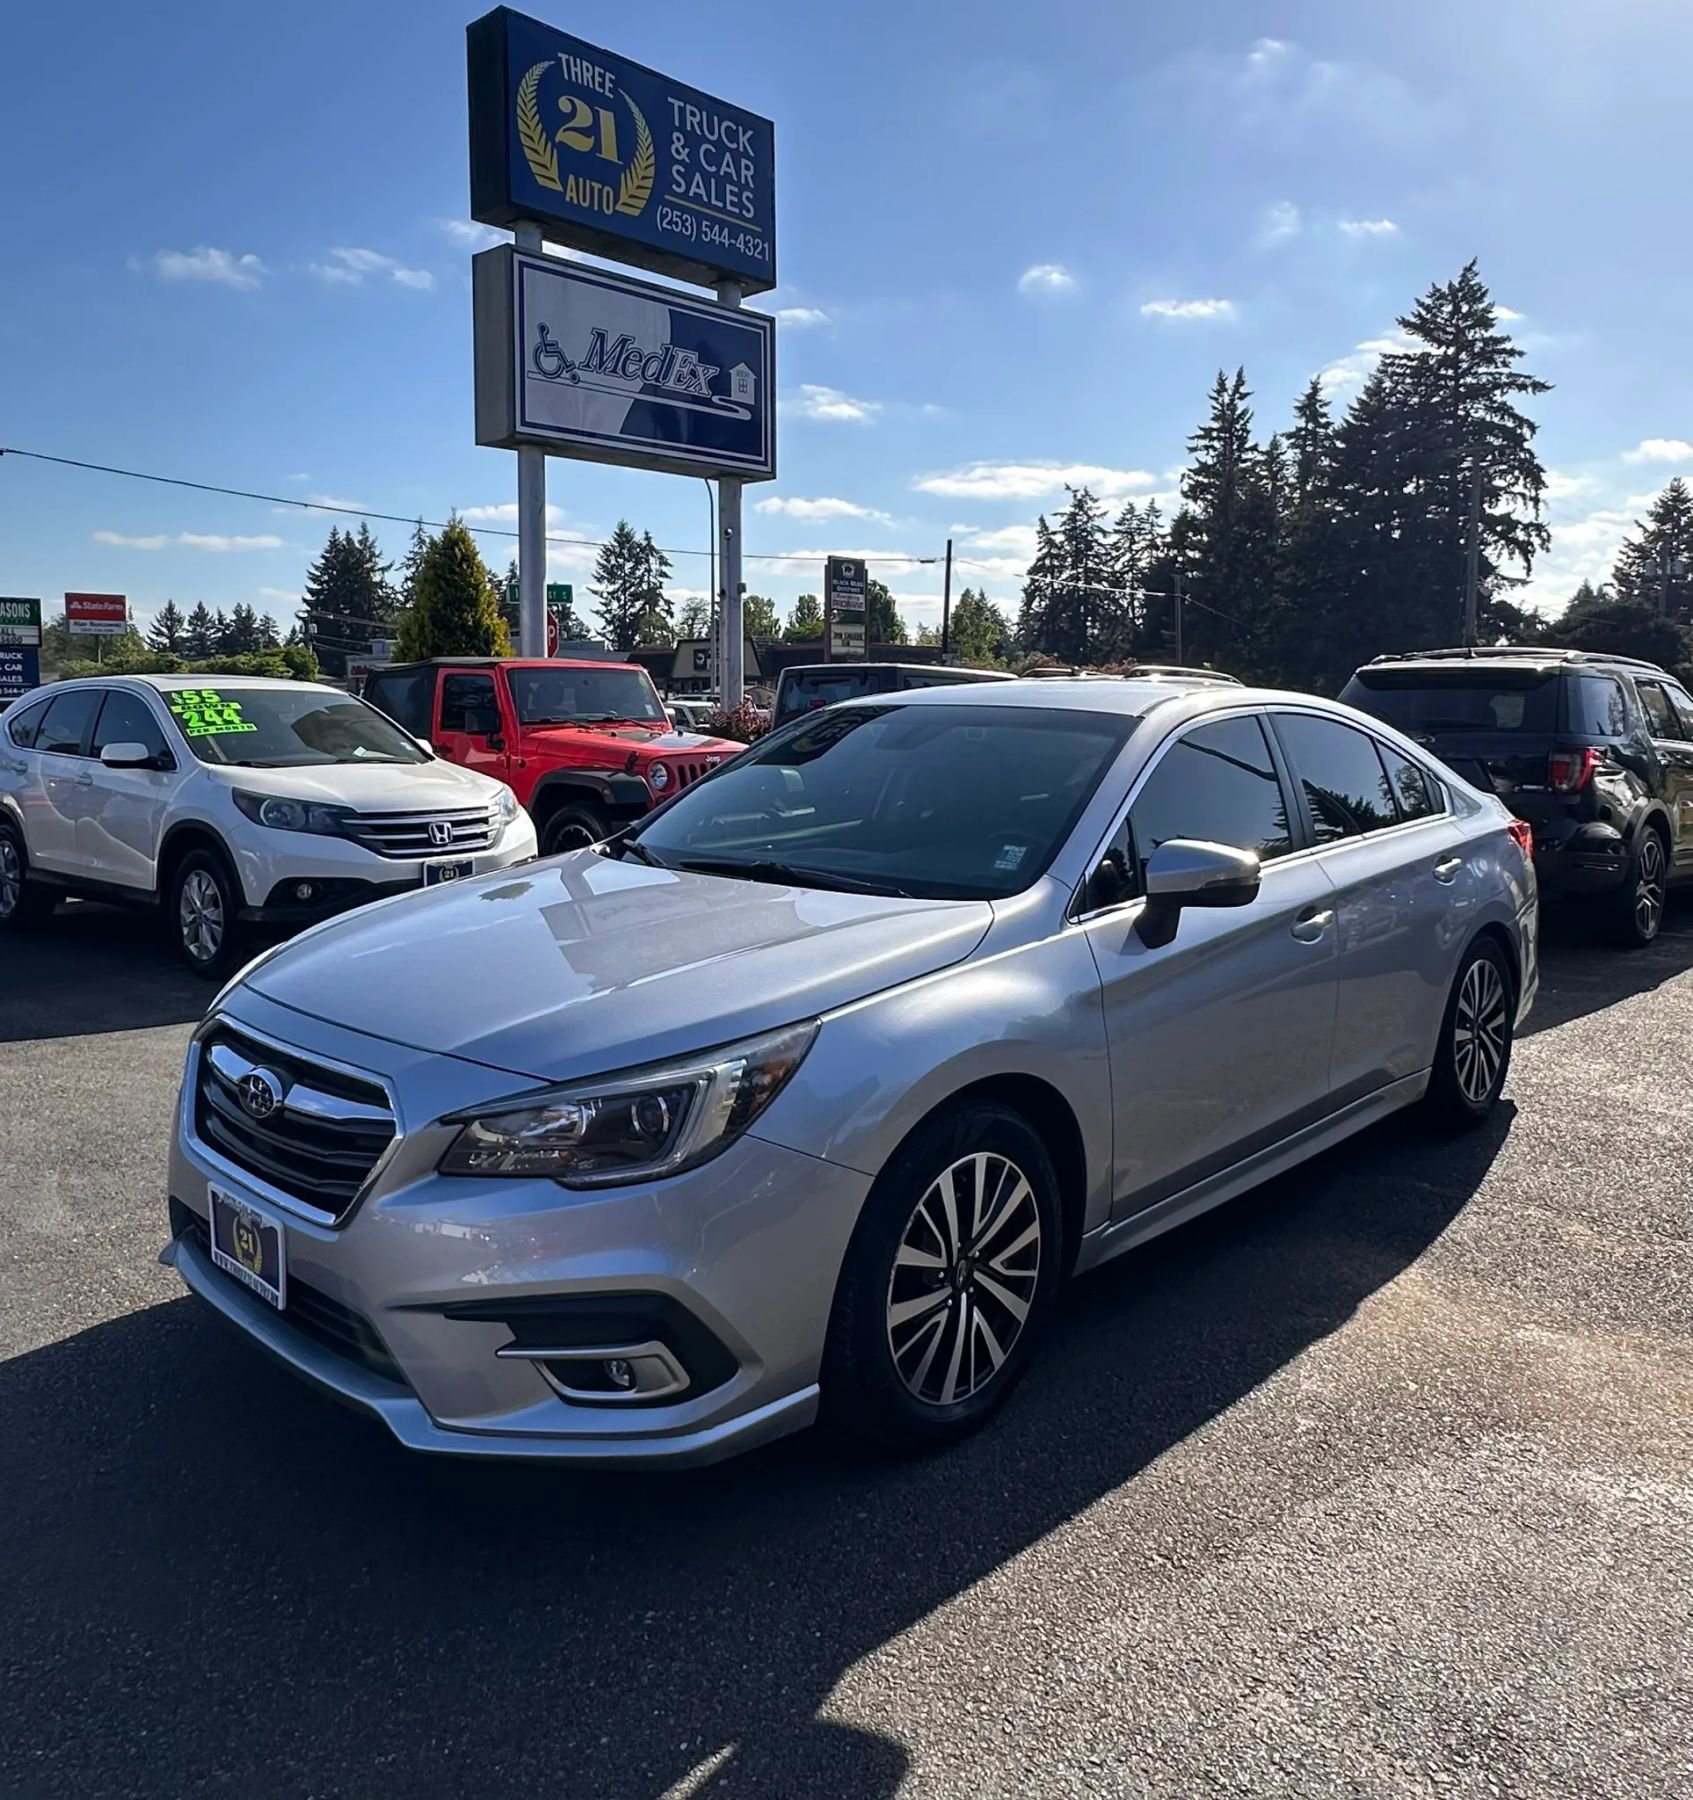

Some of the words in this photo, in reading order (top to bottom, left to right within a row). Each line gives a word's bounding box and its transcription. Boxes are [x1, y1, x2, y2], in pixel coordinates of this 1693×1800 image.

[558, 53, 616, 99] THREE
[555, 95, 624, 165] 21
[668, 97, 755, 157] TRUCK
[670, 131, 690, 164] &
[700, 144, 755, 188] CAR
[565, 174, 615, 216] AUTO
[671, 165, 755, 219] SALES
[656, 205, 698, 242] (253)
[701, 221, 770, 261] 544-4321
[578, 327, 719, 398] MedEx
[0, 602, 31, 618] ASONS
[82, 601, 103, 610] State
[103, 602, 123, 611] Farm
[4, 663, 23, 671] CAR
[182, 709, 243, 727] 244
[706, 754, 721, 763] Jeep
[240, 1228, 256, 1256] 21
